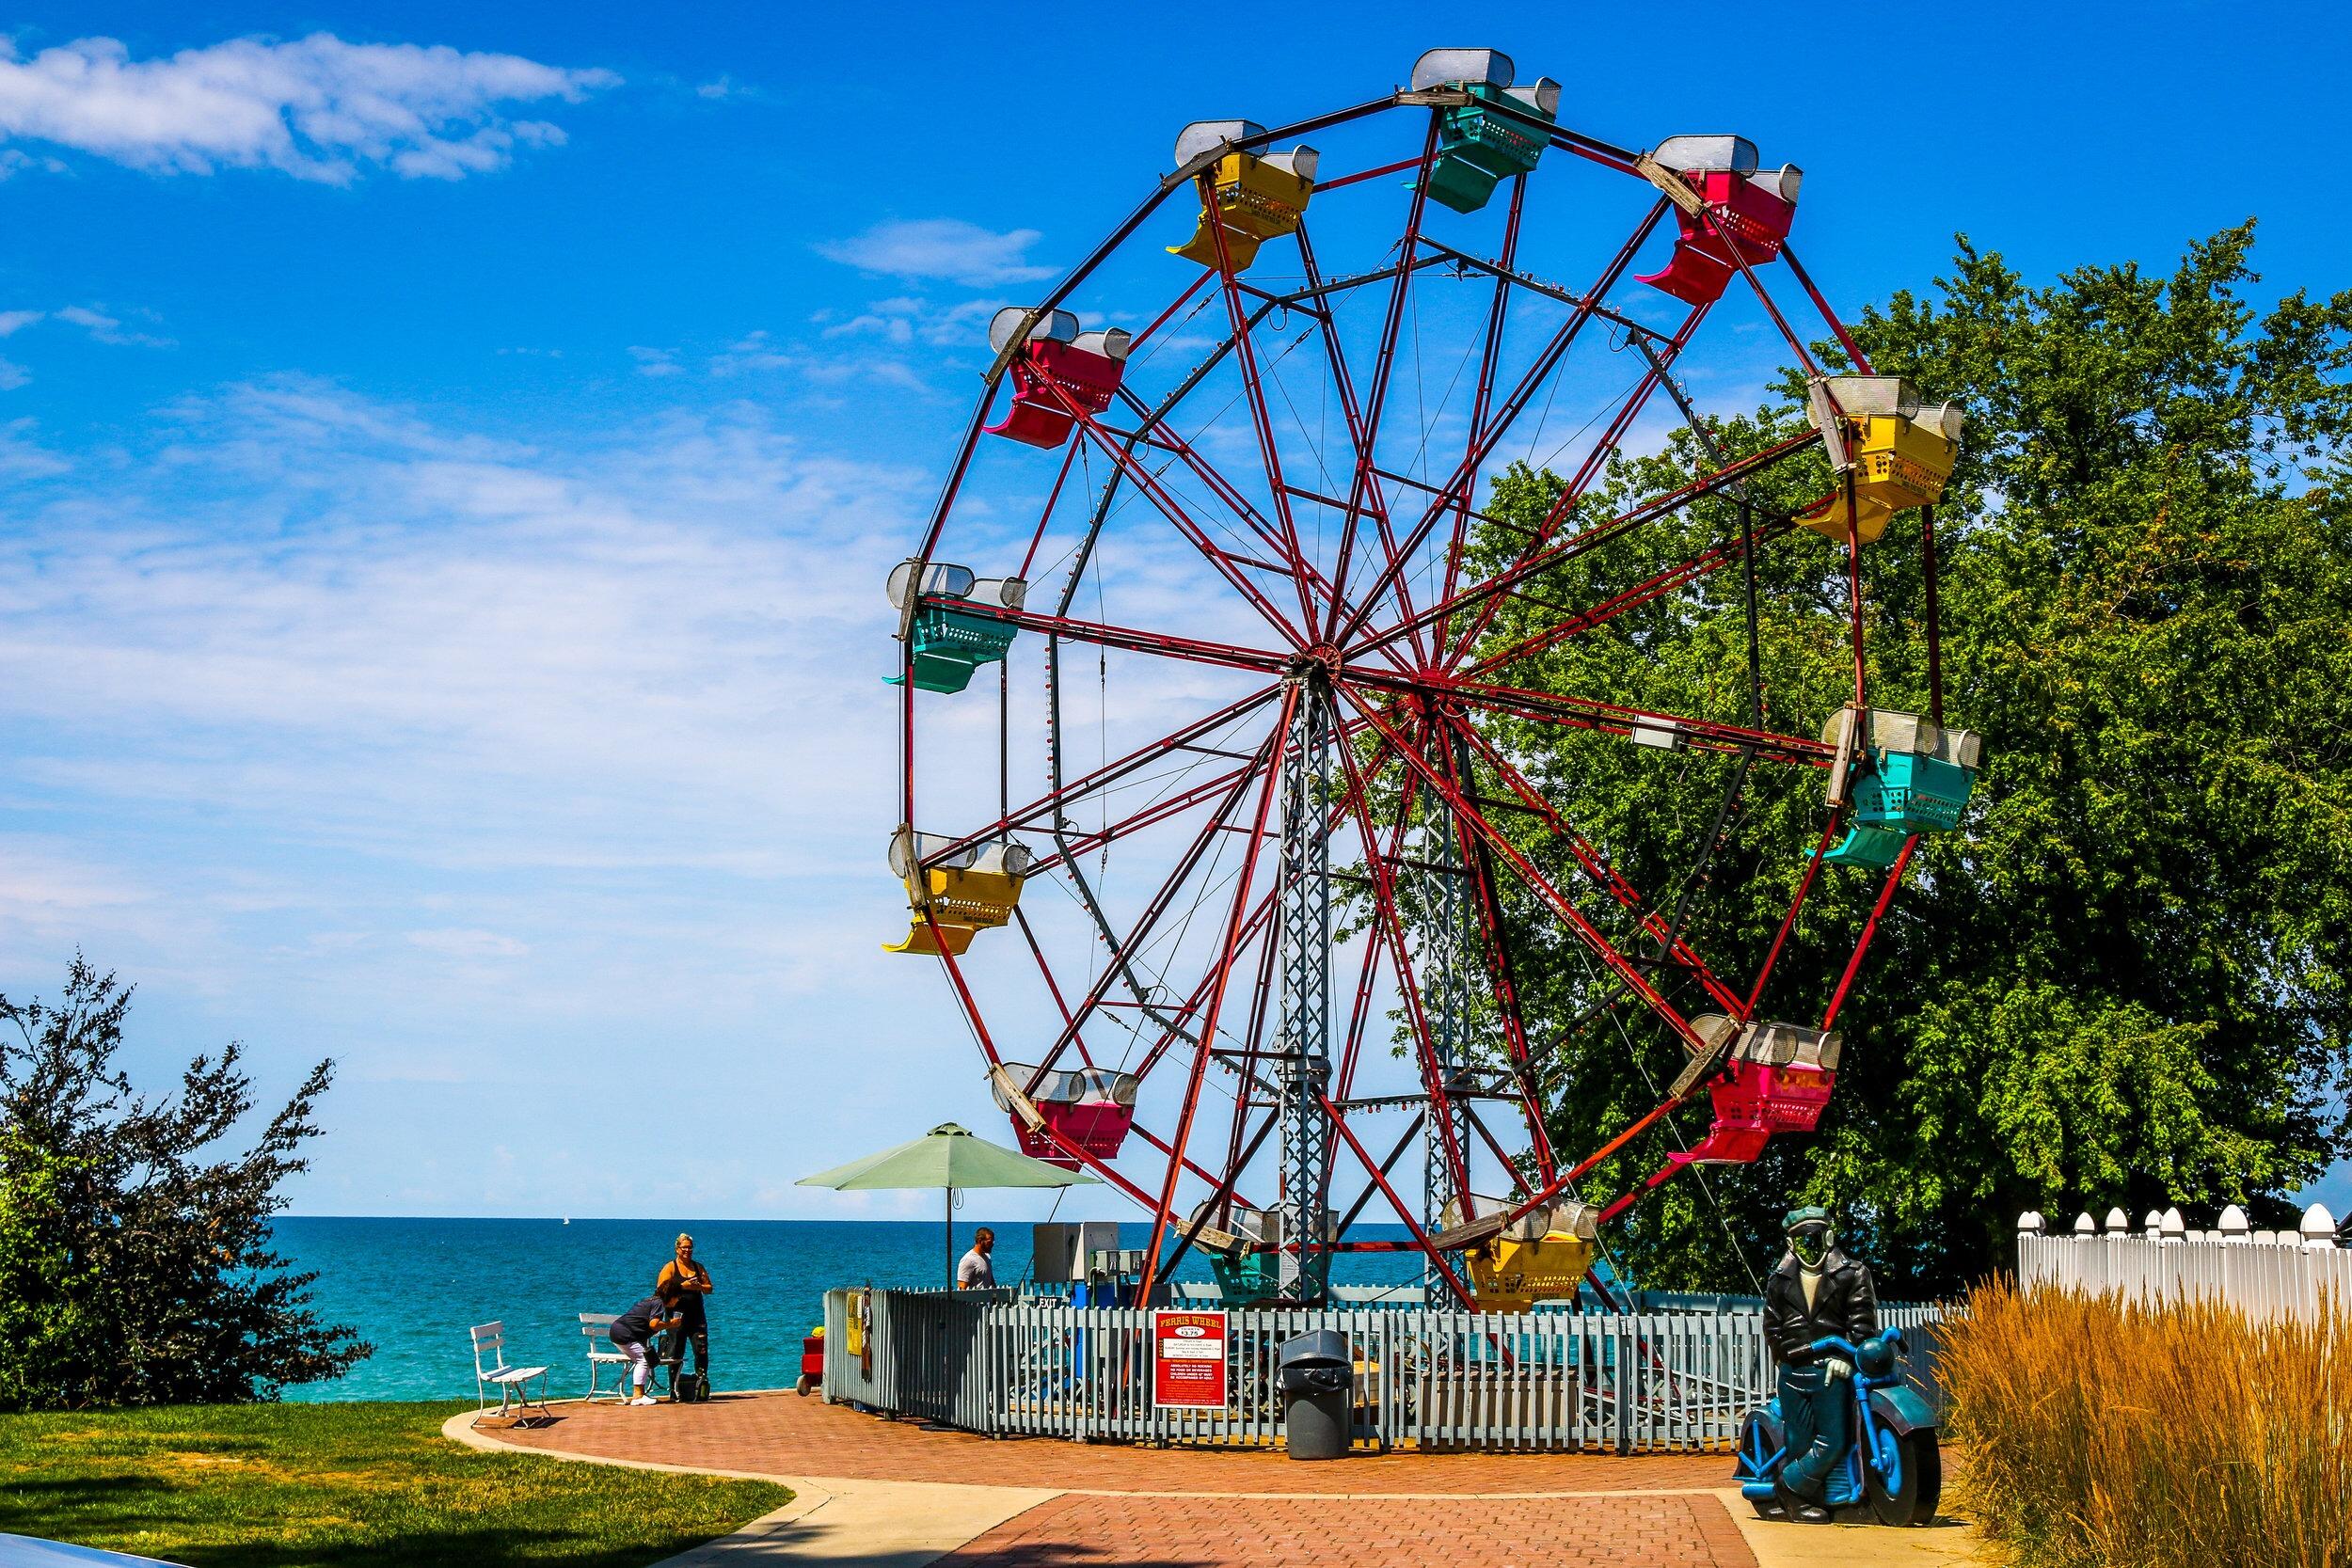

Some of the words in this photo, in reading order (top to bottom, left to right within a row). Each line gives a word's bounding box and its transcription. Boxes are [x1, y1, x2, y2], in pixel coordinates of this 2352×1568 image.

[1039, 1298, 1057, 1308] EXIT
[1160, 1316, 1190, 1327] FERRIS
[1192, 1316, 1221, 1329] WHEEL
